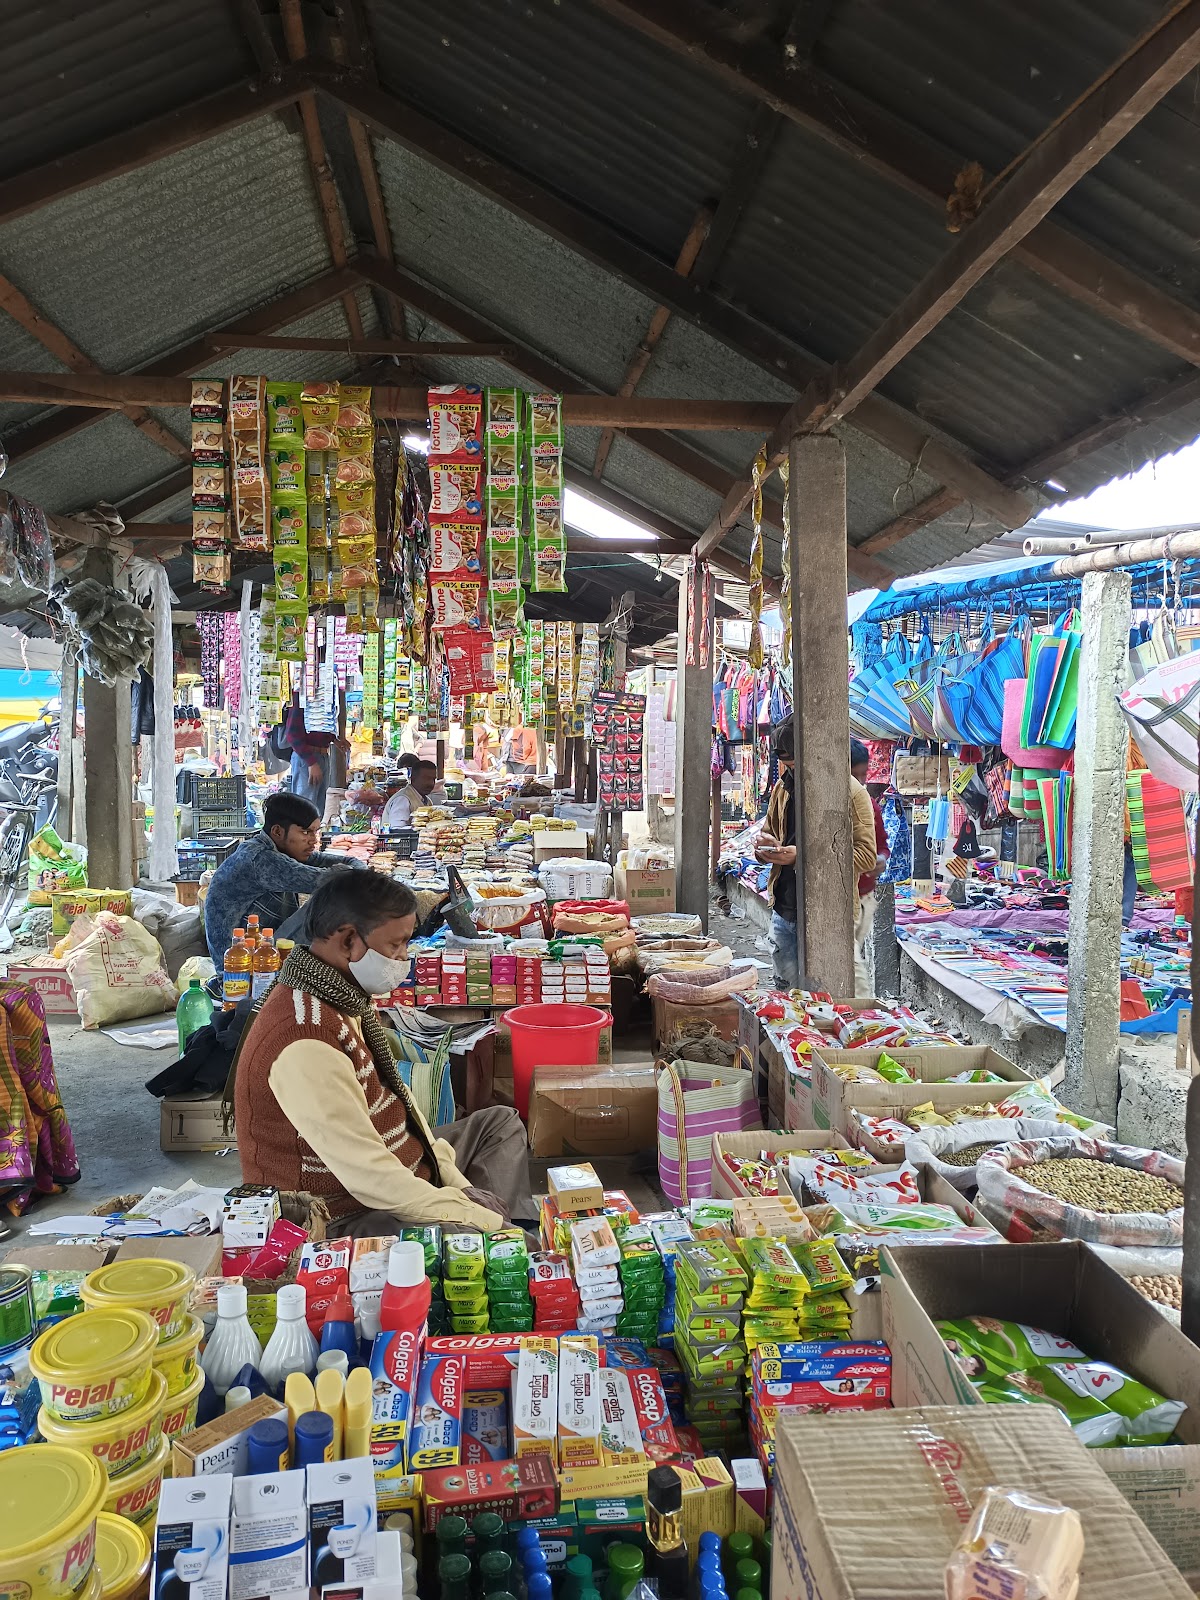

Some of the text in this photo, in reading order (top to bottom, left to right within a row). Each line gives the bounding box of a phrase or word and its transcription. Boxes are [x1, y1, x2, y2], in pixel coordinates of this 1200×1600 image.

[439, 403, 456, 411] 10%
[431, 411, 440, 450] fortune
[432, 472, 441, 509] fortune
[432, 530, 442, 569] fortune
[435, 589, 445, 624] fortune
[62, 904, 87, 915] Pejal
[106, 899, 127, 915] Pejal
[571, 1196, 592, 1204] Pears
[580, 1234, 594, 1253] LUX
[594, 1251, 608, 1259] LUX
[767, 1246, 790, 1267] Pejal
[813, 1254, 837, 1275] Pejal
[364, 1272, 381, 1280] LUX
[773, 1274, 793, 1284] Pejal
[816, 1305, 834, 1314] Pejal
[431, 1335, 522, 1352] Colgat
[833, 1347, 886, 1356] Colgate
[393, 1331, 415, 1382] Colgate
[52, 1376, 117, 1408] Pejal
[440, 1358, 460, 1408] Colgate
[390, 1392, 403, 1420] Cibaca
[638, 1373, 660, 1421] closeup
[162, 1404, 188, 1434] jal
[469, 1409, 478, 1432] Cibaca
[442, 1420, 453, 1446] Cibaca
[201, 1442, 240, 1472] Pears
[371, 1446, 390, 1454] olgate
[419, 1450, 454, 1465] 59
[373, 1458, 394, 1466] baca
